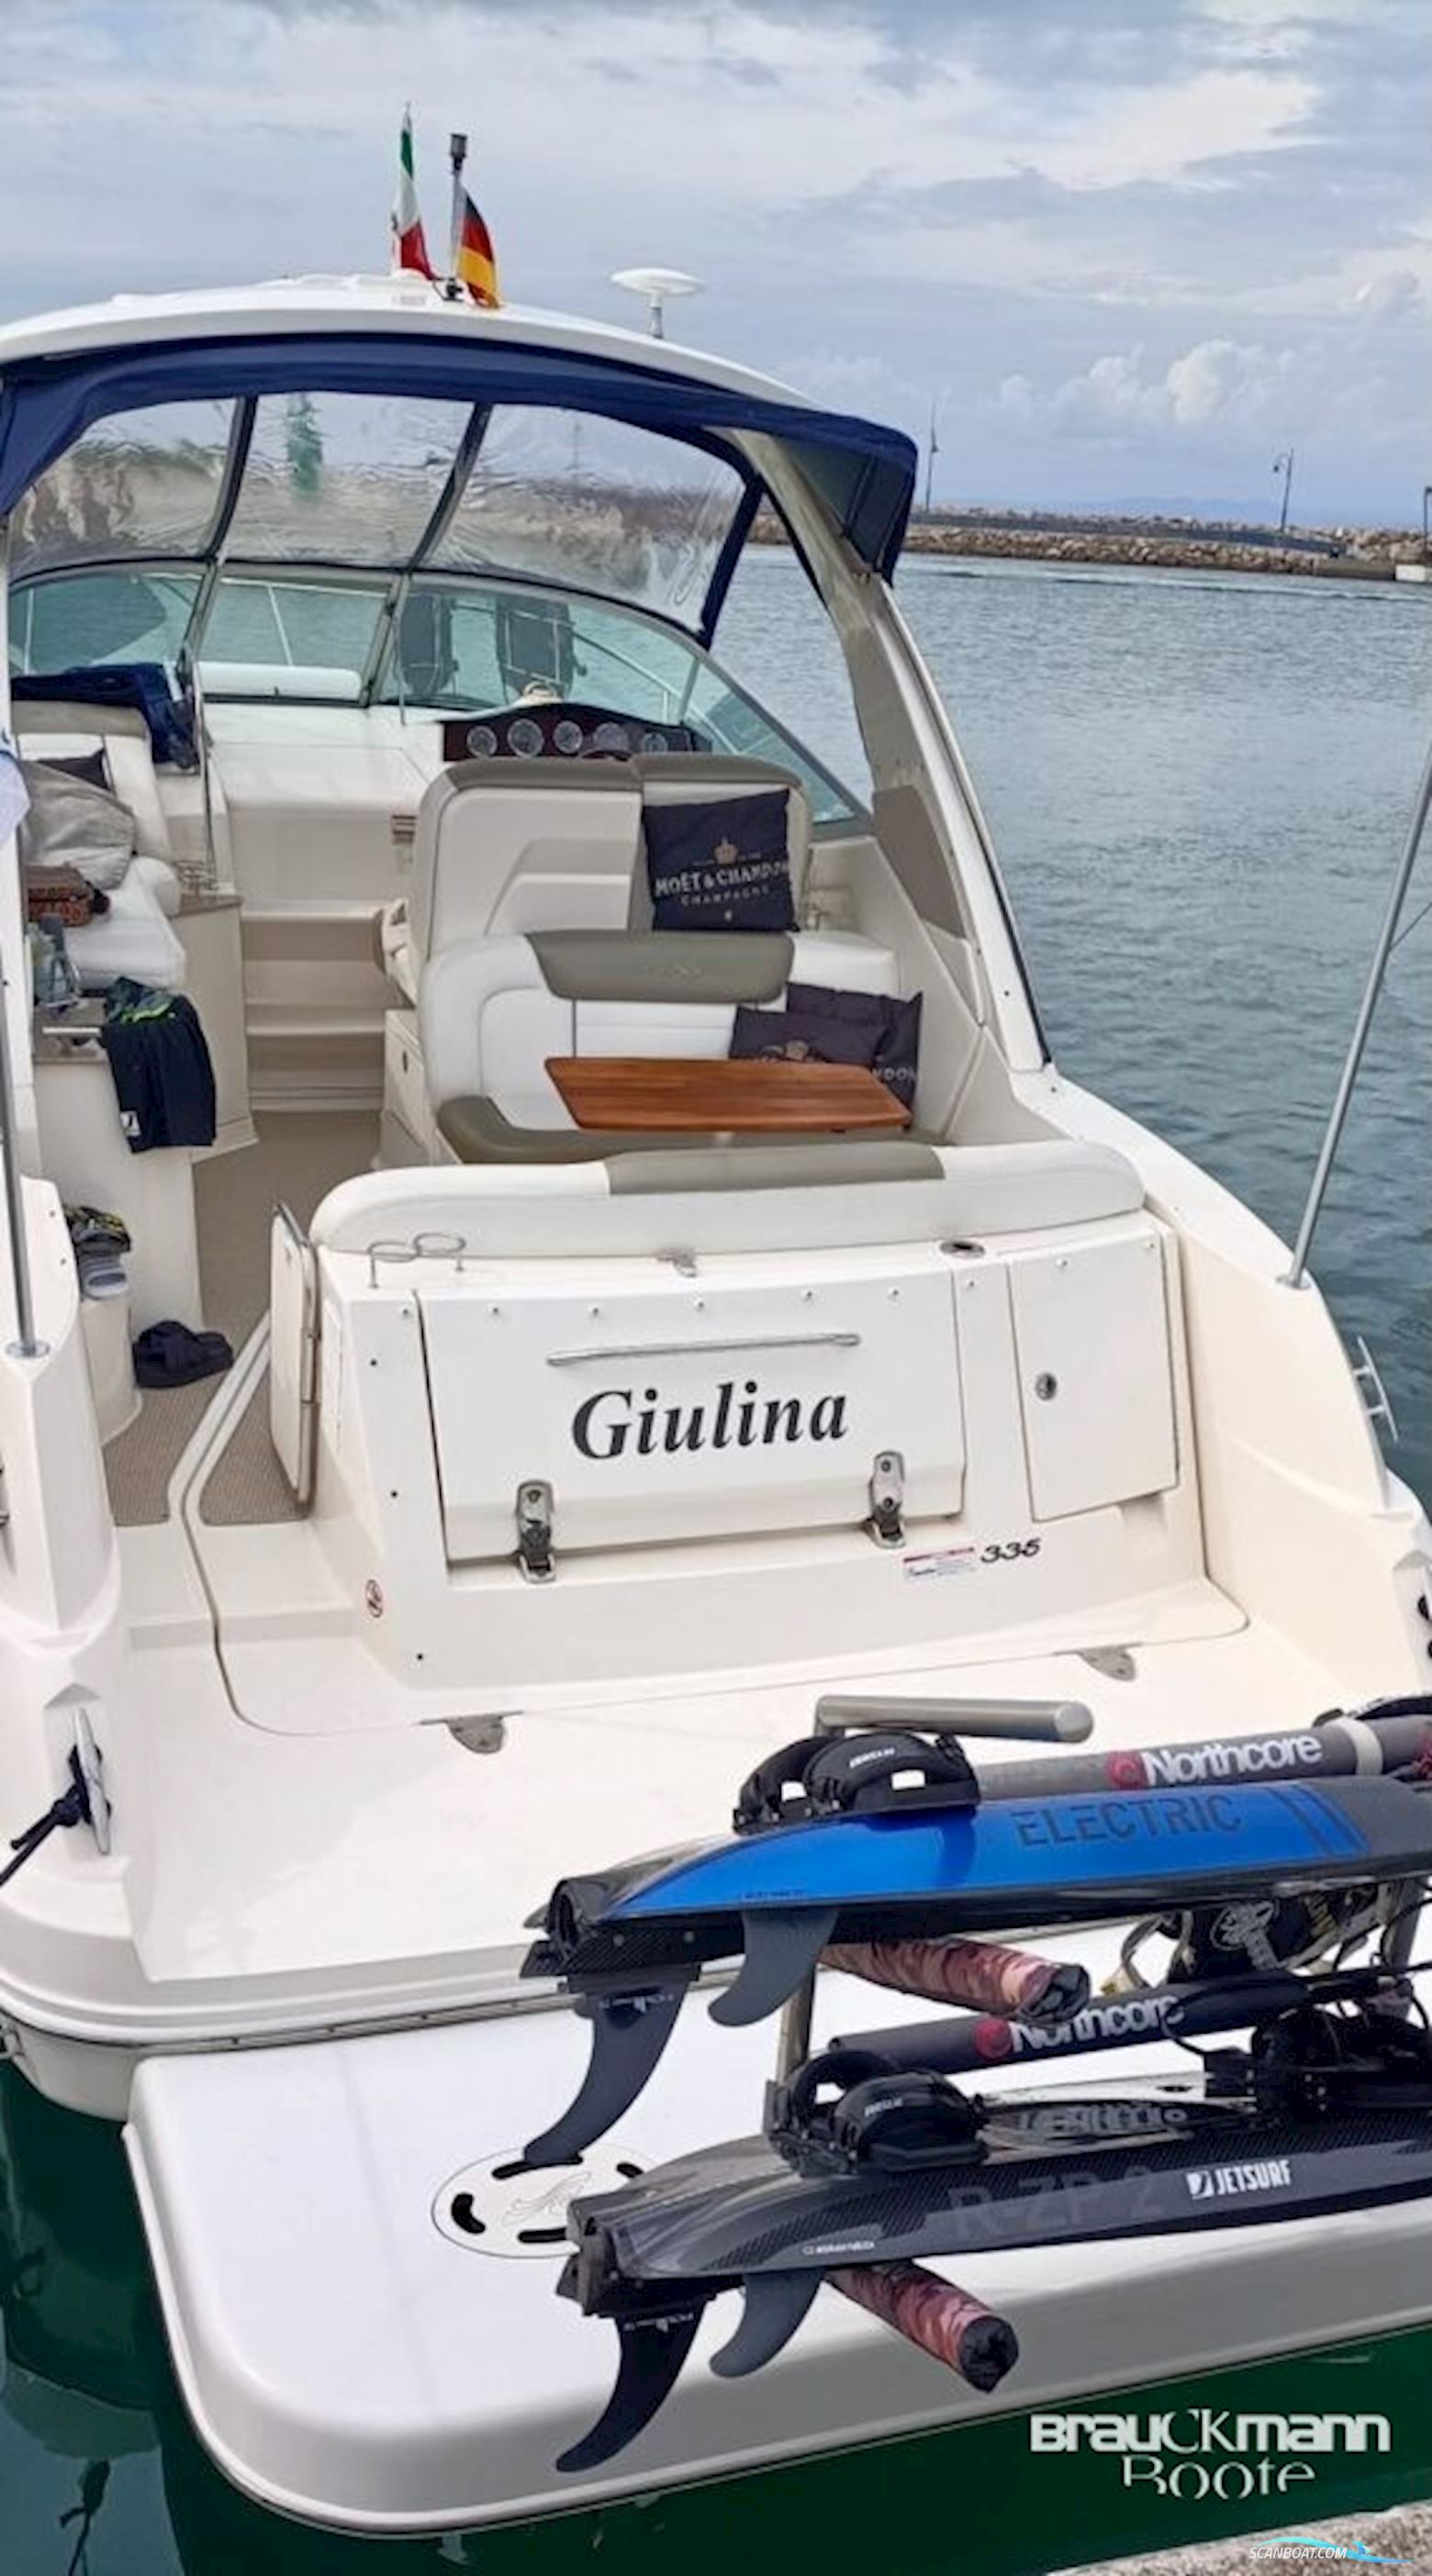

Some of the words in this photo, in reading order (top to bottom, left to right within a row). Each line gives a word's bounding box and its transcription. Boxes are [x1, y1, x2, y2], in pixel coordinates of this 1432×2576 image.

[571, 1380, 848, 1460] Giulina
[980, 1537, 1041, 1564] 335
[1142, 1734, 1323, 1786] Northcore
[1016, 1795, 1242, 1848] ELECTRIC
[1216, 2159, 1292, 2196] JETSURF
